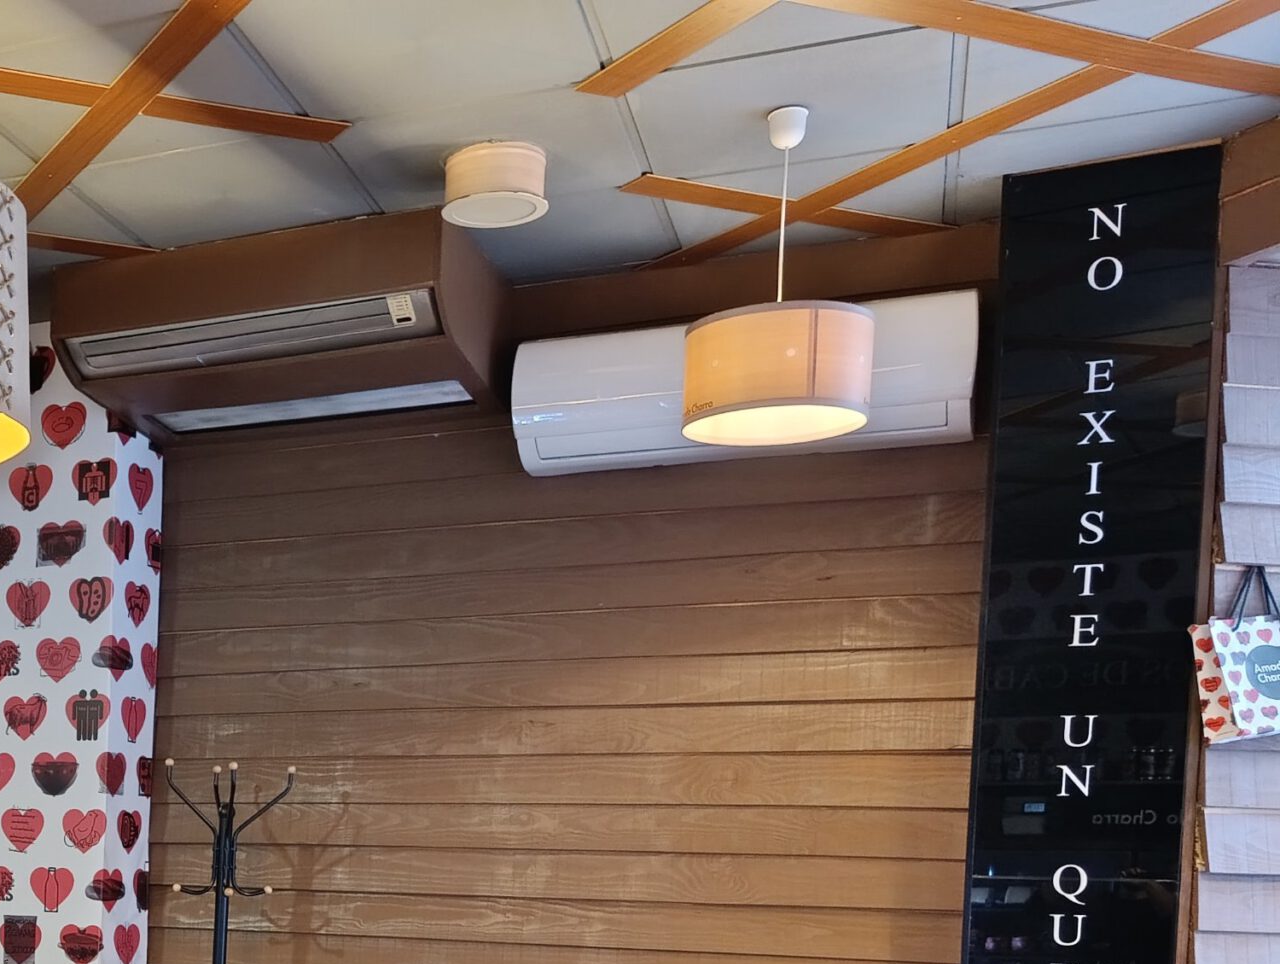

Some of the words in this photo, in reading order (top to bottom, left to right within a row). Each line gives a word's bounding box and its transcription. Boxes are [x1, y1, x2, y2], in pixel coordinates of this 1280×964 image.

[1086, 202, 1127, 290] NO
[1067, 358, 1116, 648] EXISTE
[1056, 714, 1098, 797] UN
